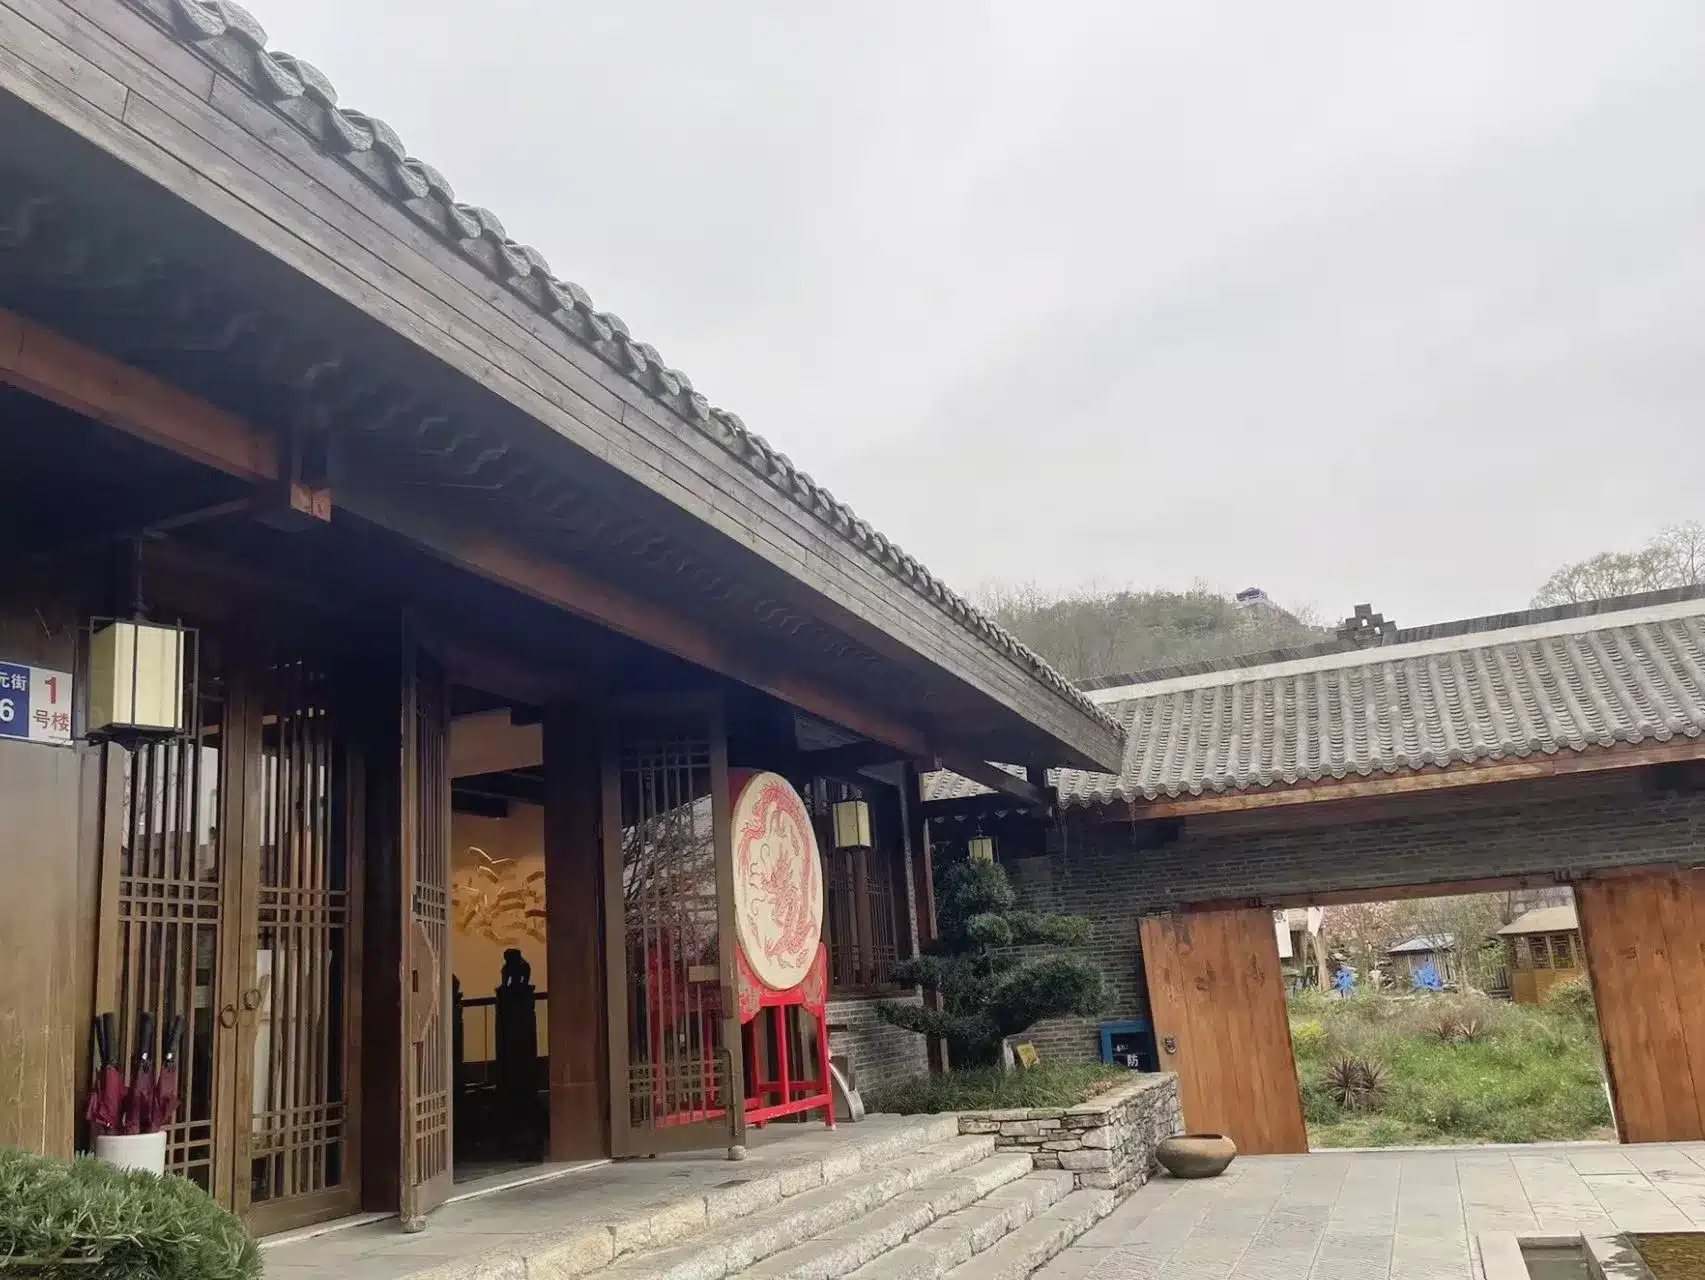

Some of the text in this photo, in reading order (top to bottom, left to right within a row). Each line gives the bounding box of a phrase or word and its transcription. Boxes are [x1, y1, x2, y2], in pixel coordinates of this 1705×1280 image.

[44, 677, 57, 704] 1
[0, 698, 15, 722] 6
[33, 709, 69, 732] 号楼
